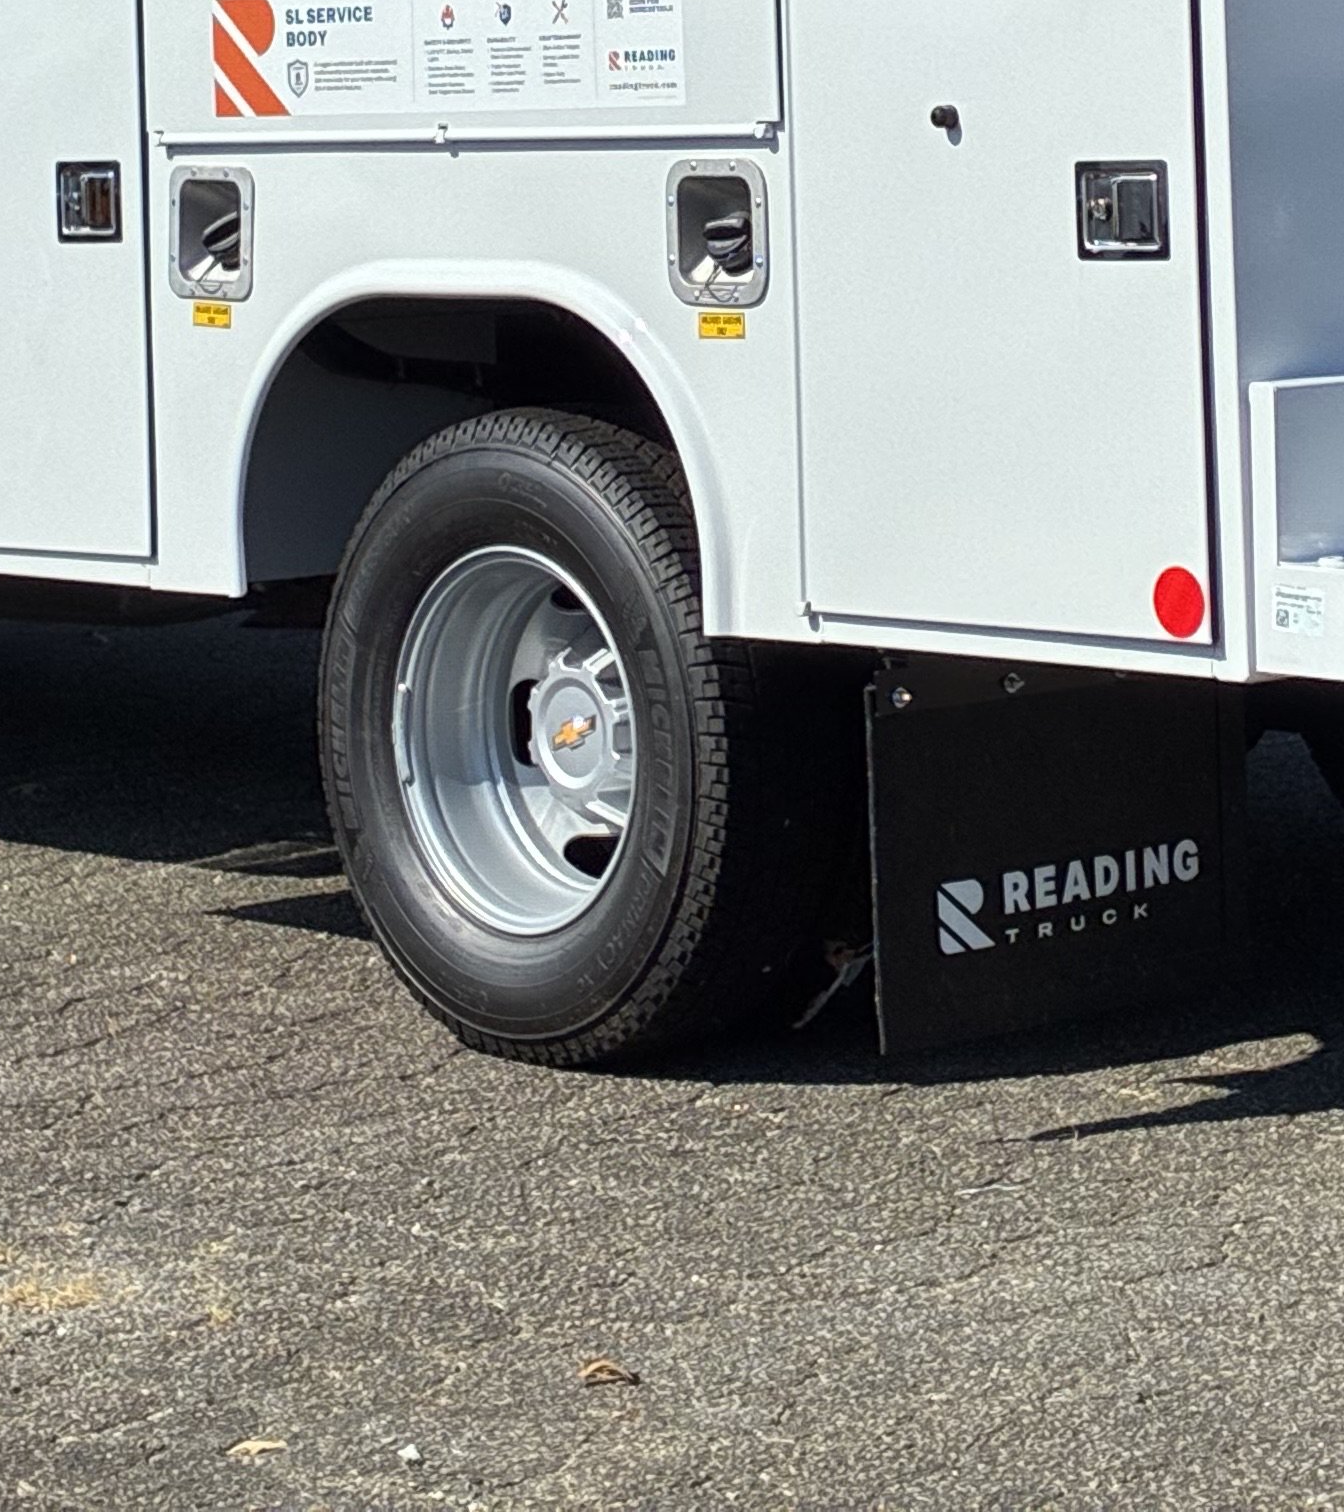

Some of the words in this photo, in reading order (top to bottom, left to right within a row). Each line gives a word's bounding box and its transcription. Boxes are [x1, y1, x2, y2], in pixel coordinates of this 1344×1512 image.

[285, 8, 304, 25] SL
[306, 6, 374, 24] SERVICE
[286, 30, 327, 48] BODY
[623, 48, 676, 63] READING
[1002, 838, 1200, 916] READING
[1005, 902, 1149, 944] TRUCK
